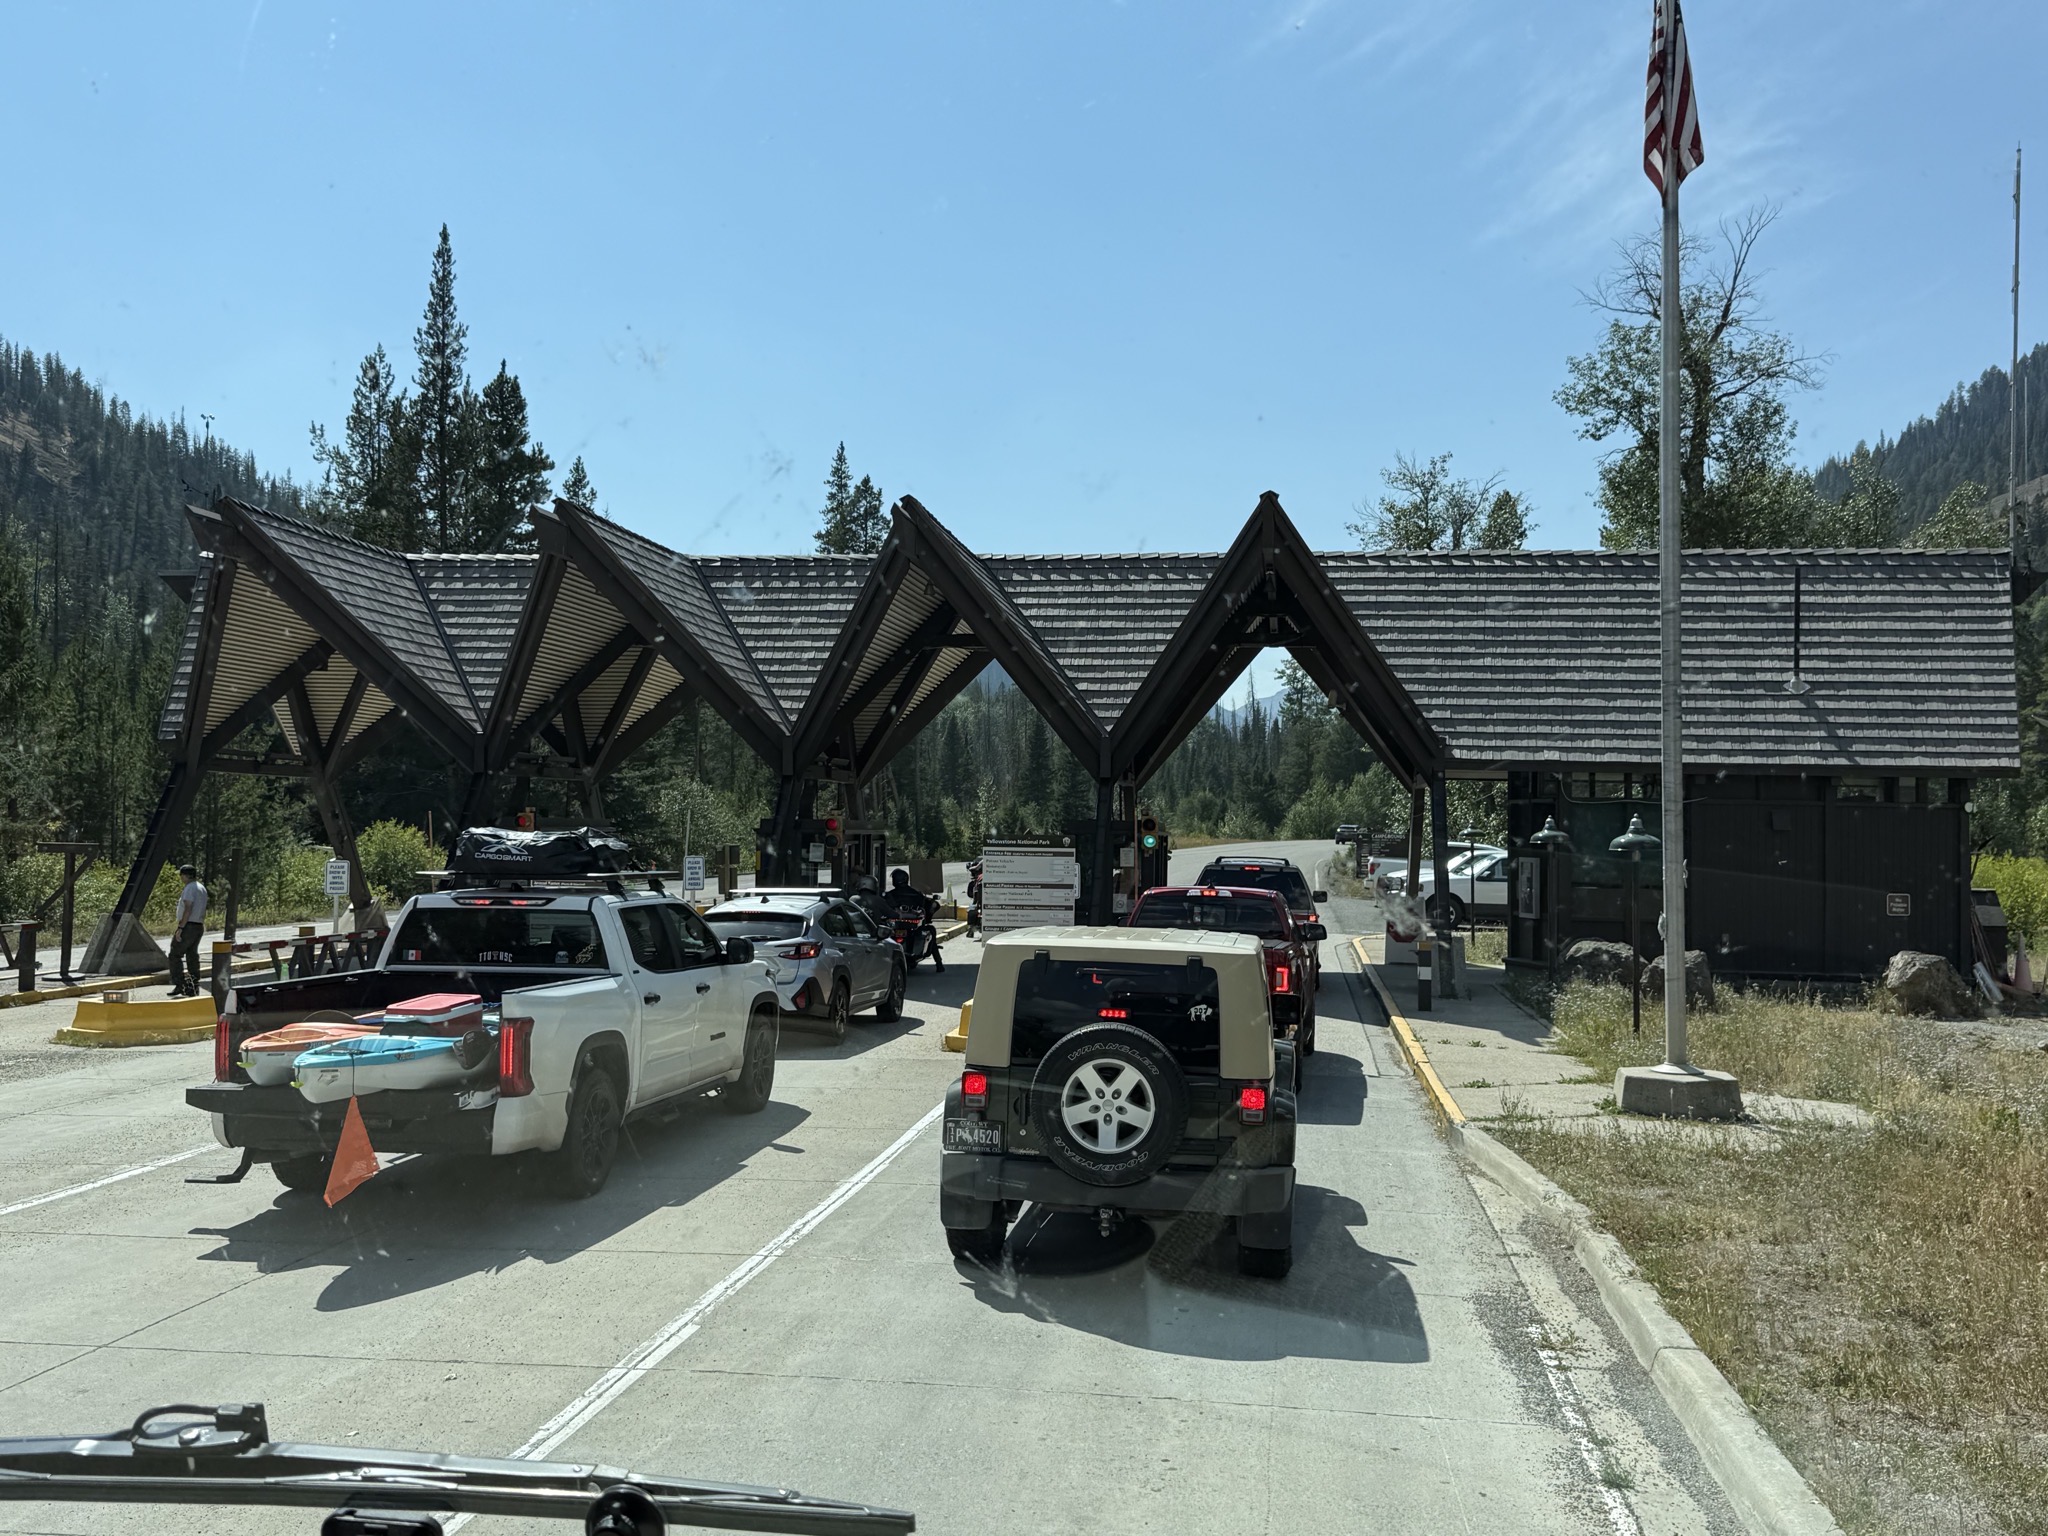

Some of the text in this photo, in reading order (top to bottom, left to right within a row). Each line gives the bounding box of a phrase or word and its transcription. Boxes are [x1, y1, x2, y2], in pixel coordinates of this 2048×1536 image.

[478, 951, 492, 963] TTU
[1068, 1042, 1160, 1075] WRANGLER
[1054, 1136, 1149, 1171] GOODYEAR
